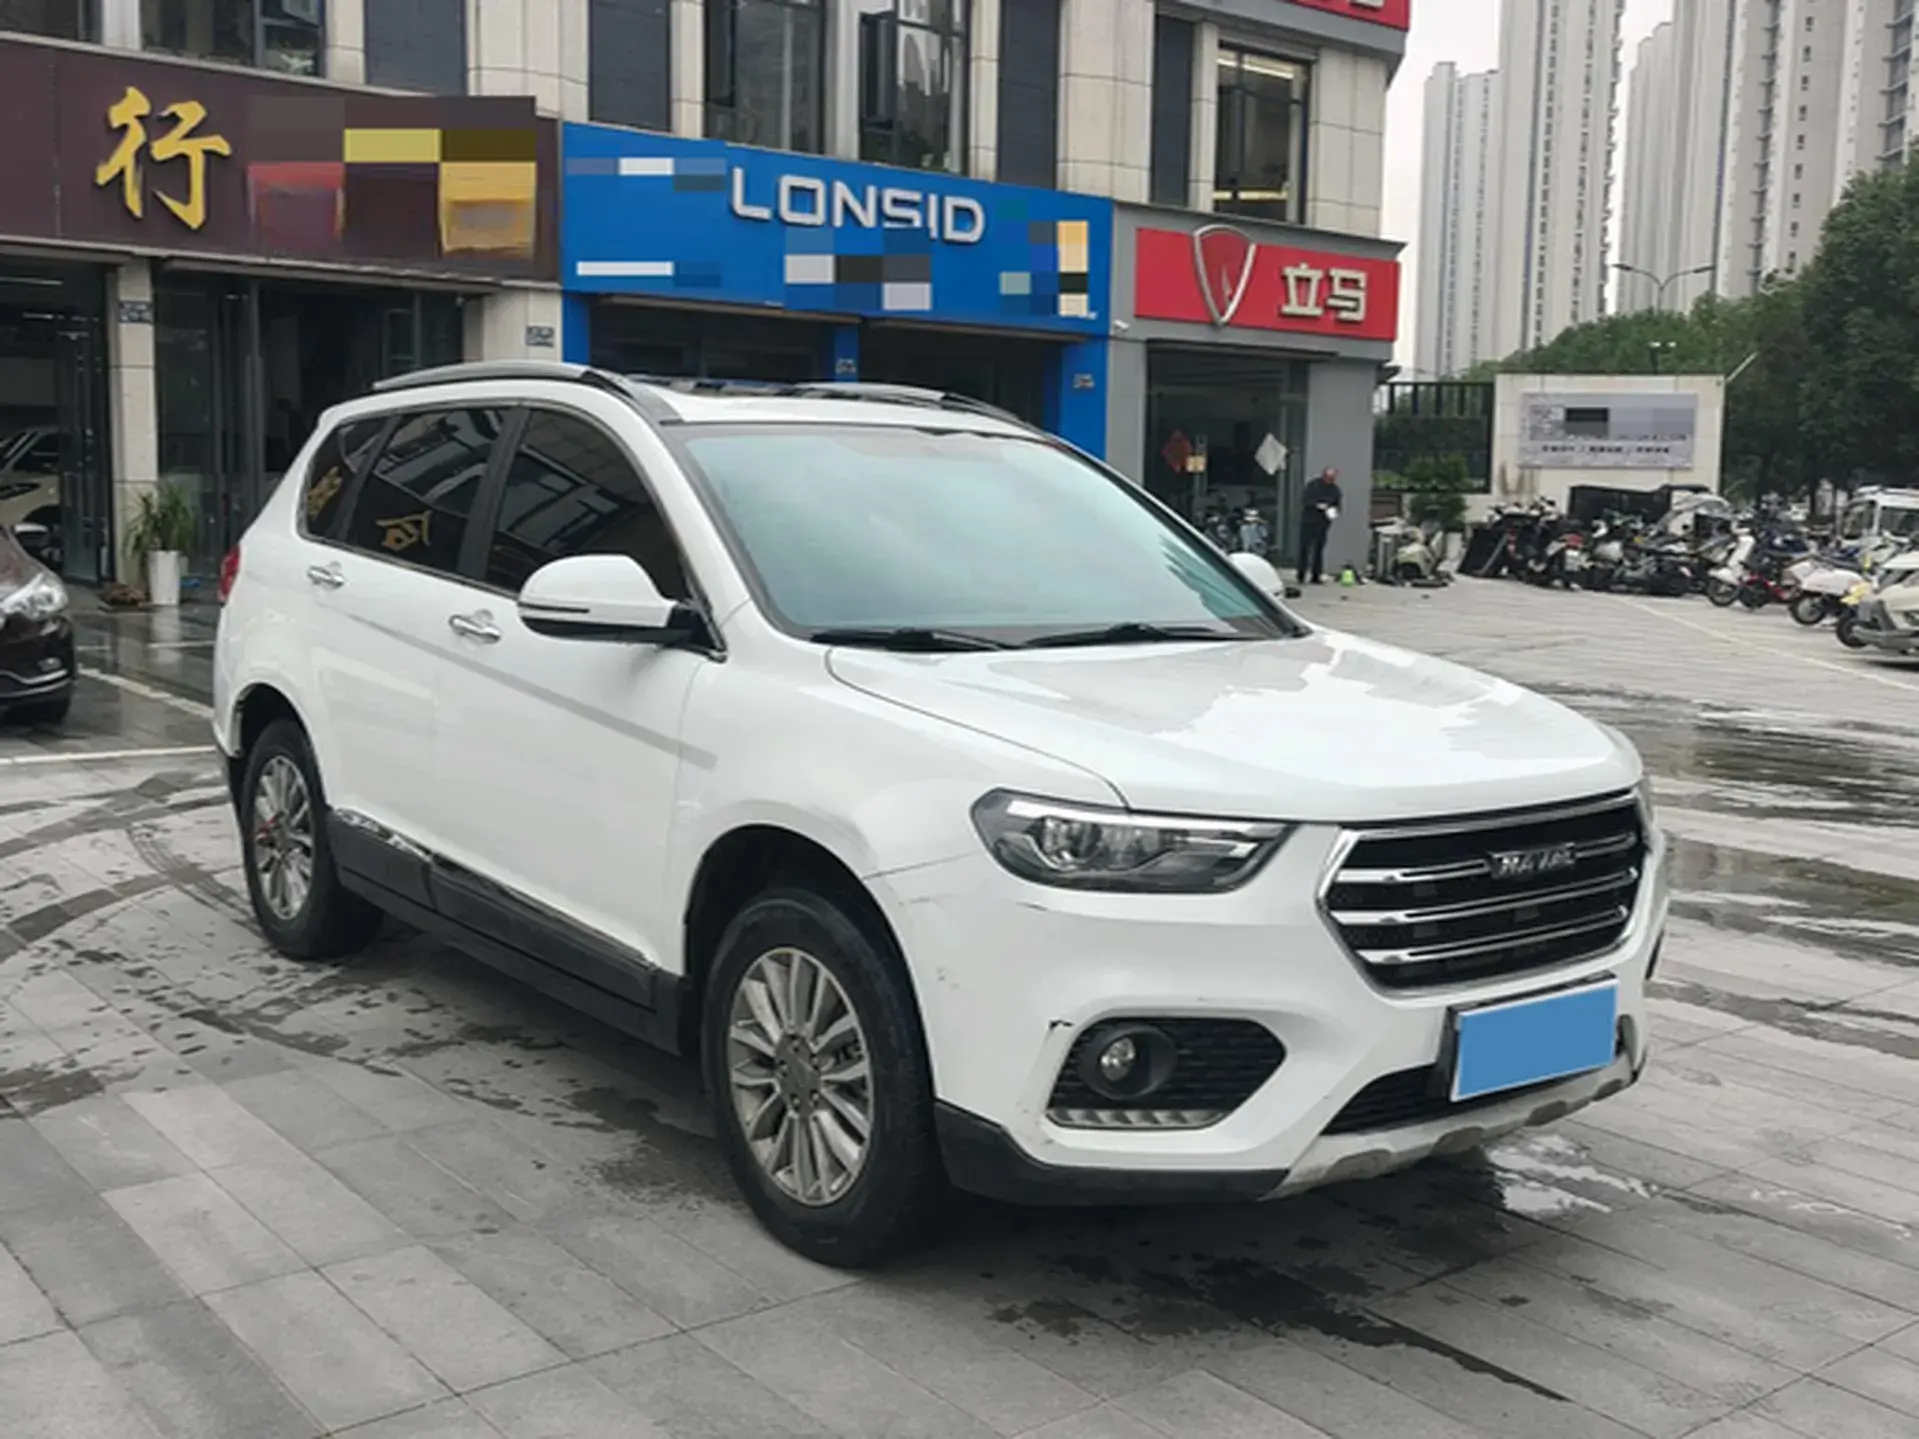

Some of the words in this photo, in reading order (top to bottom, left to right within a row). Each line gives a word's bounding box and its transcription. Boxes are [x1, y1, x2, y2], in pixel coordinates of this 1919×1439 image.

[96, 86, 232, 229] 行
[731, 166, 985, 243] LONSID
[1281, 262, 1366, 322] 立马
